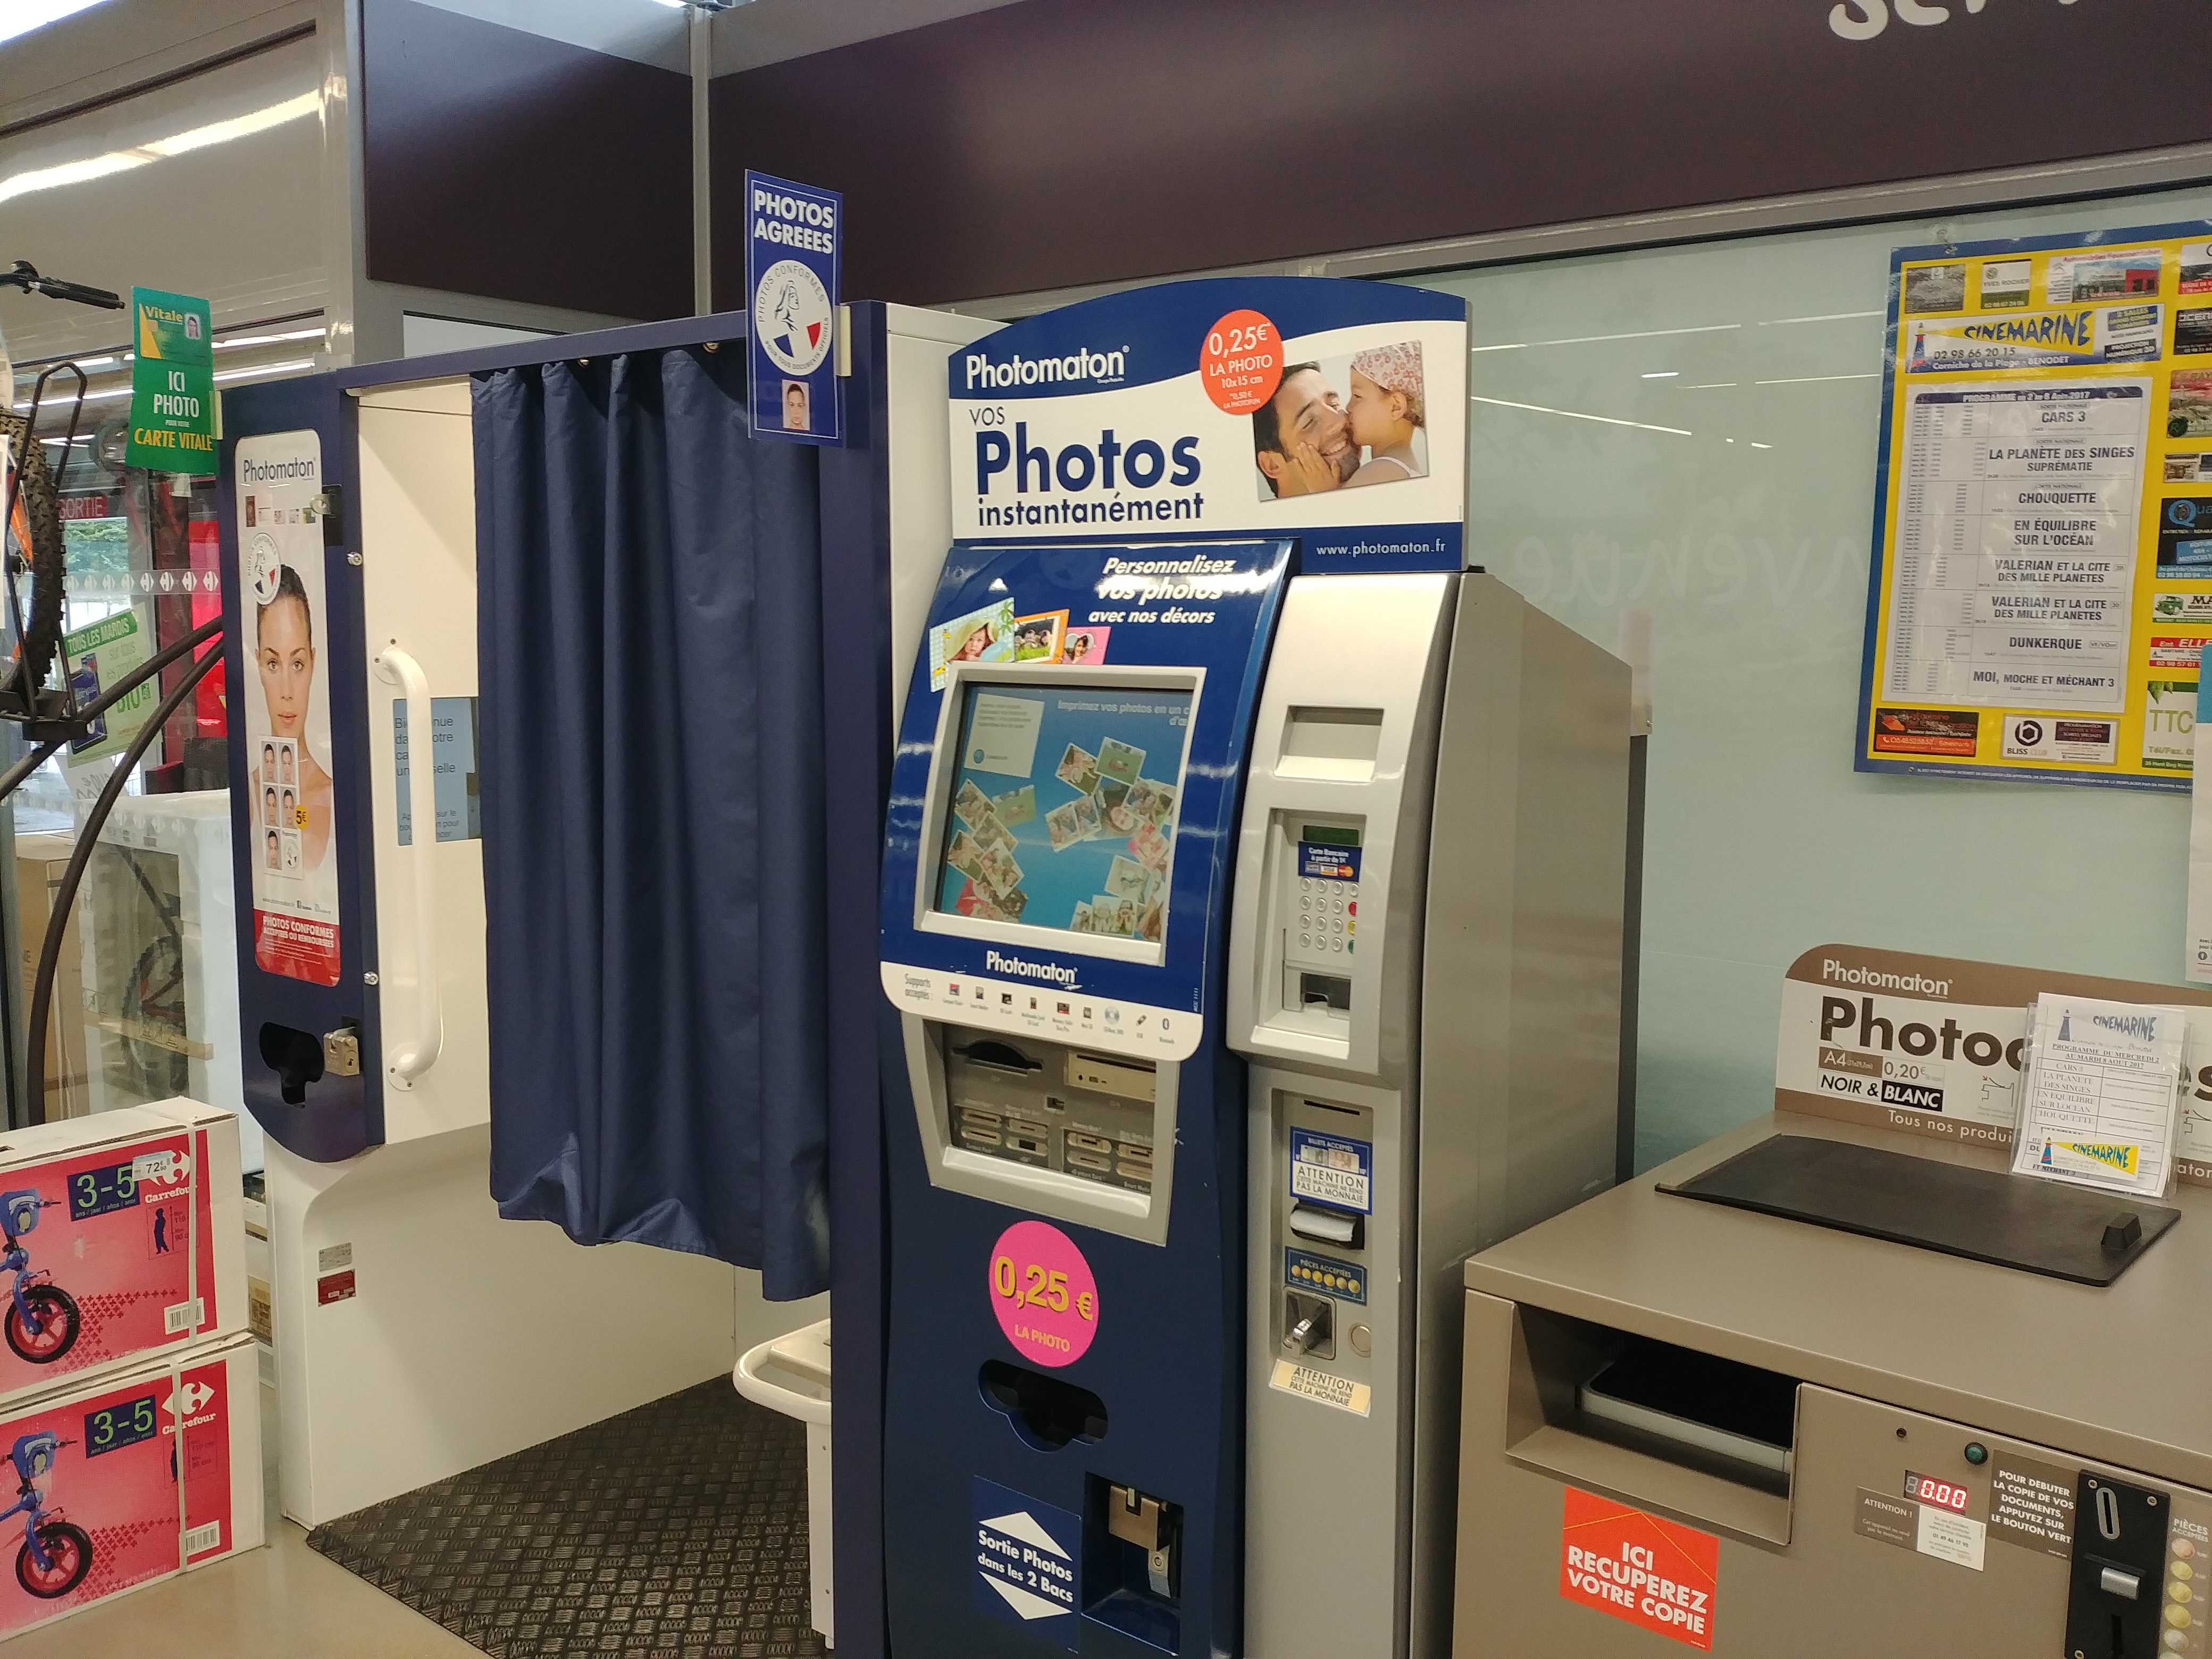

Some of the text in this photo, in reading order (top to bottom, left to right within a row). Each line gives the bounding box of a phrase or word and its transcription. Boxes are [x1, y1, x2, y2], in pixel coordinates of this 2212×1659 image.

[755, 189, 834, 229] PHOTOS
[755, 217, 833, 254] AGREEES
[758, 265, 825, 323] PHOTOS CONFORMES
[145, 305, 183, 322] Vitale
[1964, 311, 2093, 346] CINEMARINE
[1934, 347, 2015, 359] 02 98 66 20 15
[966, 346, 1125, 390] Photomaton
[1210, 355, 1273, 376] LA PHOTO
[169, 371, 185, 391] ICI
[1221, 375, 1248, 389] 10x15
[154, 394, 199, 417] PHOTO
[2041, 411, 2085, 423] CARS 3
[969, 407, 1006, 428] VOS
[135, 428, 213, 451] CARTE VITALE
[976, 422, 1202, 496] Photos
[1989, 446, 2134, 459] LA PLANÈTE DES SINGES
[244, 457, 315, 482] Photomaton
[2027, 460, 2093, 472] SUPRÉMATIE
[977, 491, 1204, 527] instantanément
[2019, 492, 2096, 504] CHOUQUETTE
[2014, 517, 2097, 531] EN ÉQUILIBRE
[1316, 538, 1446, 558] www.photomaton.fr
[2014, 532, 2093, 546] SUR L'OCÉAN
[1103, 555, 1236, 575] Personnalisez
[1995, 559, 2110, 572] VALERIAN ET LA CITE
[1998, 573, 2105, 583] DES MILLE PLANETES
[1096, 579, 1224, 605] vos photos
[1992, 596, 2107, 609] VALERIAN ET LA CITE
[1088, 607, 1215, 624] avec nos décors
[1995, 609, 2102, 620] DES MILLE PLANETES
[2009, 637, 2082, 650] DUNKERQUE
[1973, 671, 2114, 687] MOI, MOCHE ET MÉCHANT 3
[2149, 709, 2193, 734] TTC
[263, 916, 334, 939] PHOTOS CONFORMES
[986, 950, 1075, 984] Photomaton
[1822, 959, 1948, 997] Photomaton
[2093, 1015, 2157, 1042] CINEMARINE
[1824, 1050, 1846, 1066] A4
[2052, 1043, 2100, 1055] PROGRAMME
[2115, 1052, 2155, 1062] MERCREDI
[1821, 1074, 1941, 1108] NOIR & BLANC
[2062, 1084, 2091, 1093] SINGES
[1888, 1110, 1953, 1133] Tous nos
[2073, 1143, 2131, 1168] CINEMARINE
[146, 1162, 160, 1174] 72
[1298, 1166, 1363, 1188] ATTENTION
[77, 1166, 135, 1208] 3-5
[1297, 1181, 1363, 1203] PAS LA MONNAIE
[995, 1256, 1093, 1321] 0,25 €
[1015, 1324, 1071, 1353] LA PHOTO
[1294, 1367, 1354, 1392] ATTENTION
[1289, 1382, 1302, 1390] PAS
[1314, 1390, 1350, 1406] MONNAIE
[94, 1399, 153, 1444] 3-5
[1920, 1478, 1967, 1510] 0.00
[1994, 1480, 2074, 1510] LA COPIE DE VOS
[1999, 1470, 2070, 1497] POUR DEBUTER
[1864, 1498, 1907, 1516] ATTENTION
[1999, 1505, 2065, 1531] APPUYEZ SUR
[2001, 1494, 2064, 1520] DOCUMENTS,
[1991, 1514, 2071, 1544] LE BOUTON VERT
[2174, 1519, 2209, 1536] PIÈCES
[978, 1530, 1074, 1583] Sortie Photos
[1621, 1541, 1653, 1571] ICI
[978, 1553, 1074, 1604] dans les 2 Bacs
[1568, 1545, 1708, 1614] RECUPEREZ
[1568, 1569, 1705, 1635] VOTRE COPIE
